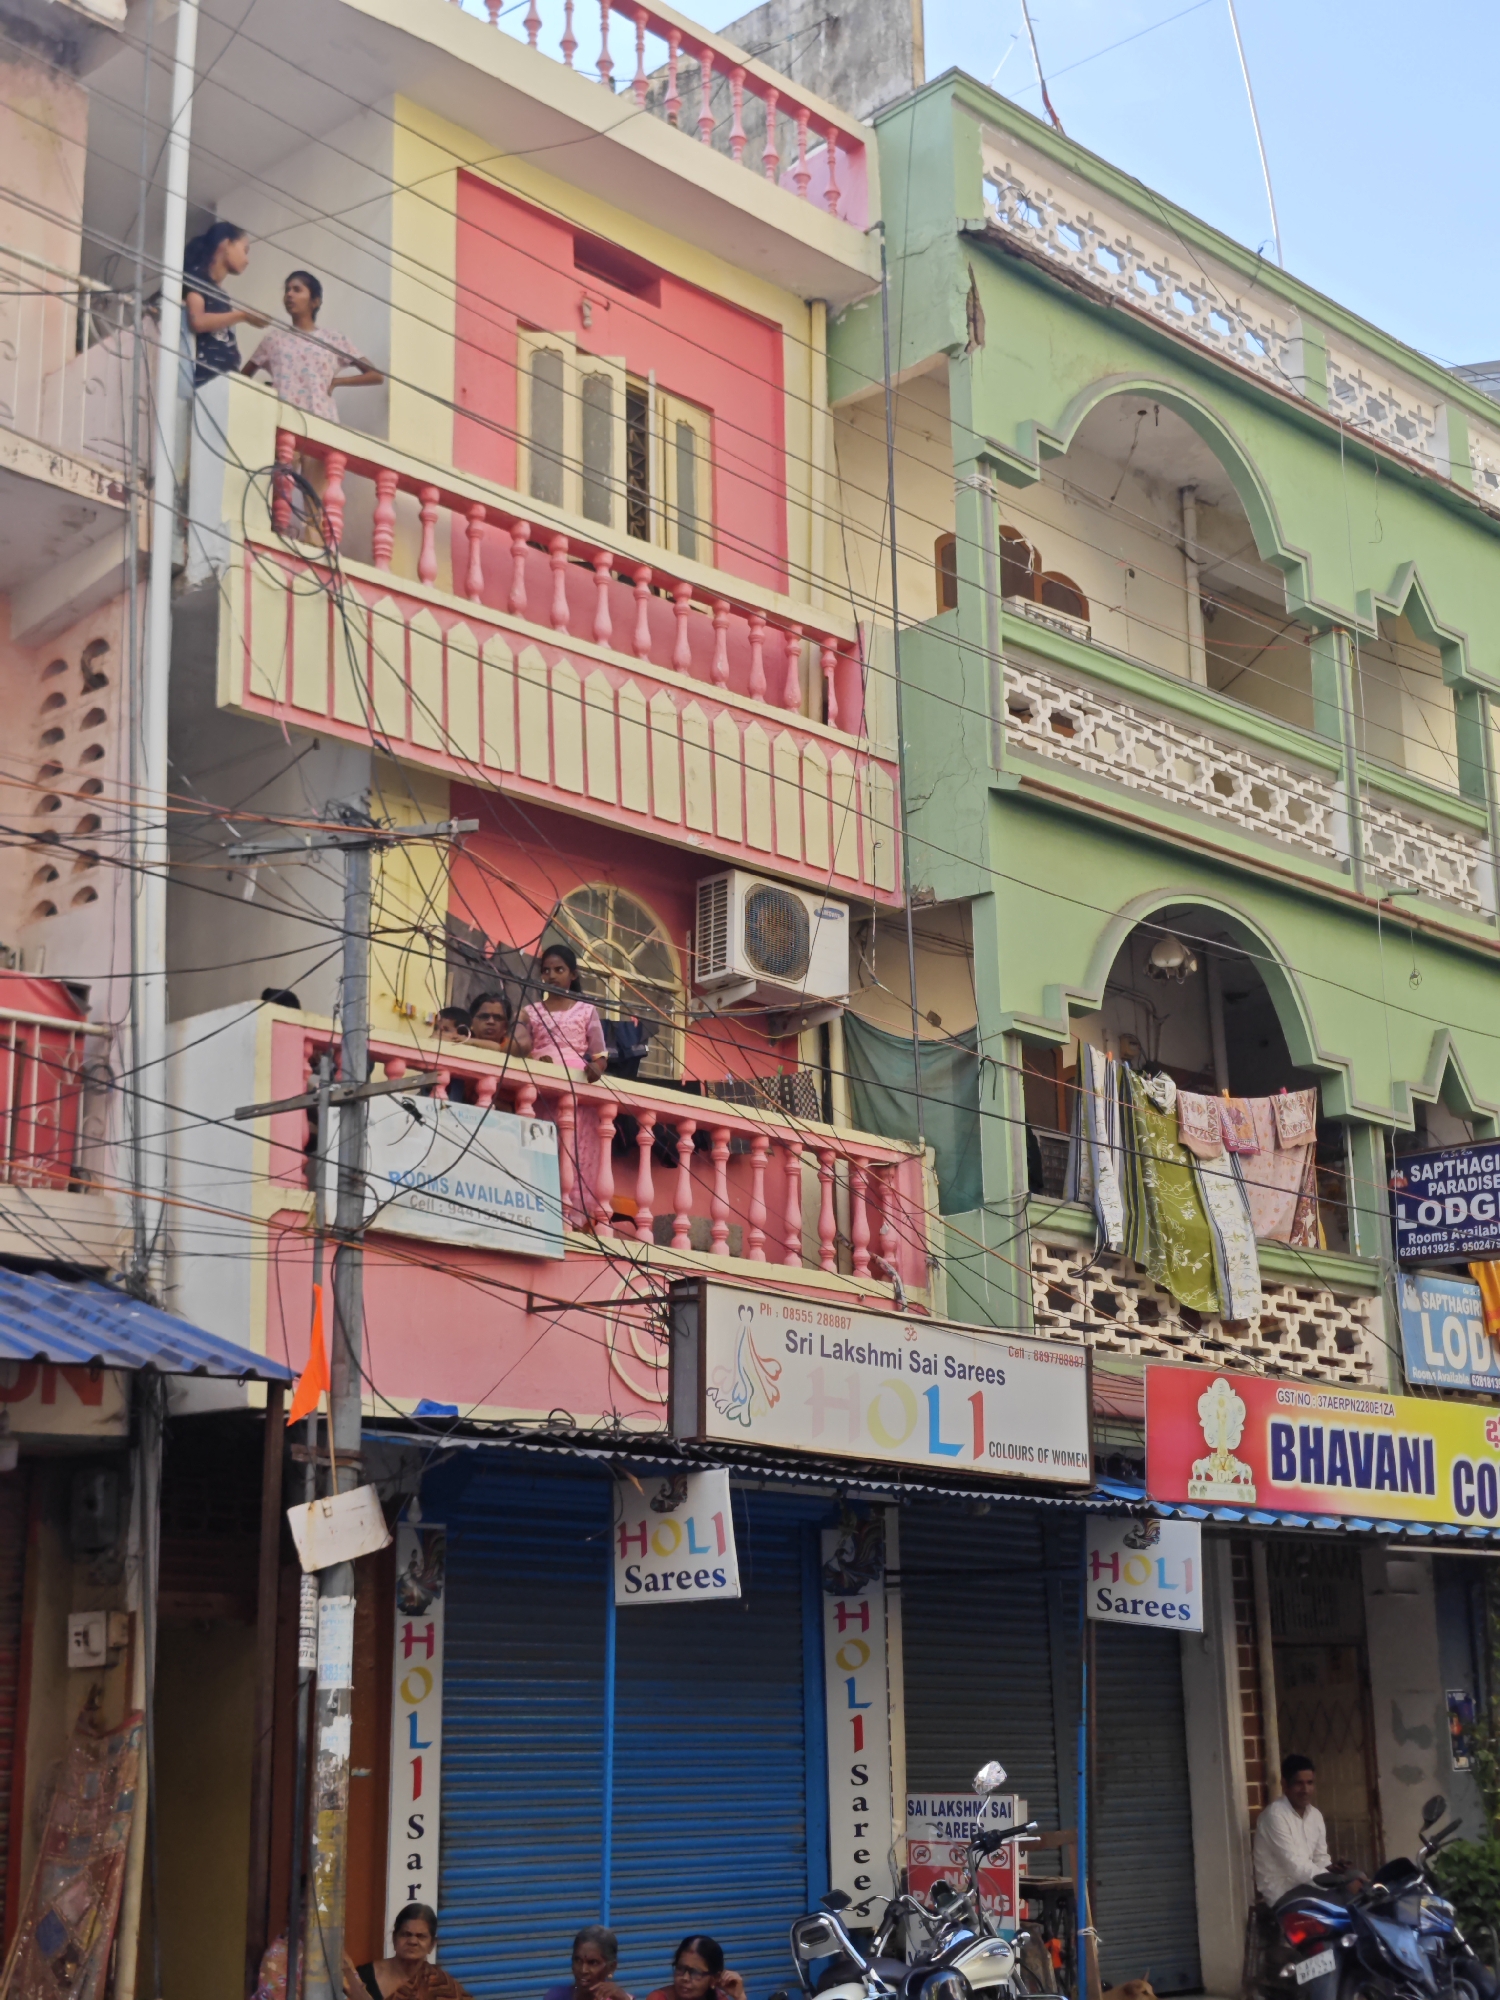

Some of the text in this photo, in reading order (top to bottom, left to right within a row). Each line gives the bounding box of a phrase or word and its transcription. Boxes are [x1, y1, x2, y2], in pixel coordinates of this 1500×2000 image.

[455, 1181, 545, 1212] AVAILABLE
[1428, 1174, 1500, 1196] PARADISE
[1397, 1192, 1500, 1230] LODG
[1408, 1231, 1448, 1245] Rooms
[759, 1303, 772, 1316] Ph
[782, 1306, 813, 1324] 08555
[817, 1312, 852, 1330] 288887
[785, 1329, 1006, 1386] Sri Lakshmi Sai Sarees
[804, 1366, 985, 1460] HOLI
[1277, 1390, 1295, 1403] GST
[1297, 1392, 1311, 1406] NO
[988, 1441, 1088, 1468] COLOURS OF WOMEN
[1271, 1422, 1436, 1495] BHAVANI
[1453, 1460, 1500, 1519] CO
[616, 1511, 727, 1560] HOLI
[624, 1564, 727, 1594] Sarees
[1088, 1549, 1194, 1594] HOLI
[1096, 1587, 1191, 1621] Sarees
[907, 1800, 927, 1817] SAI
[991, 1801, 1012, 1818] SAI
